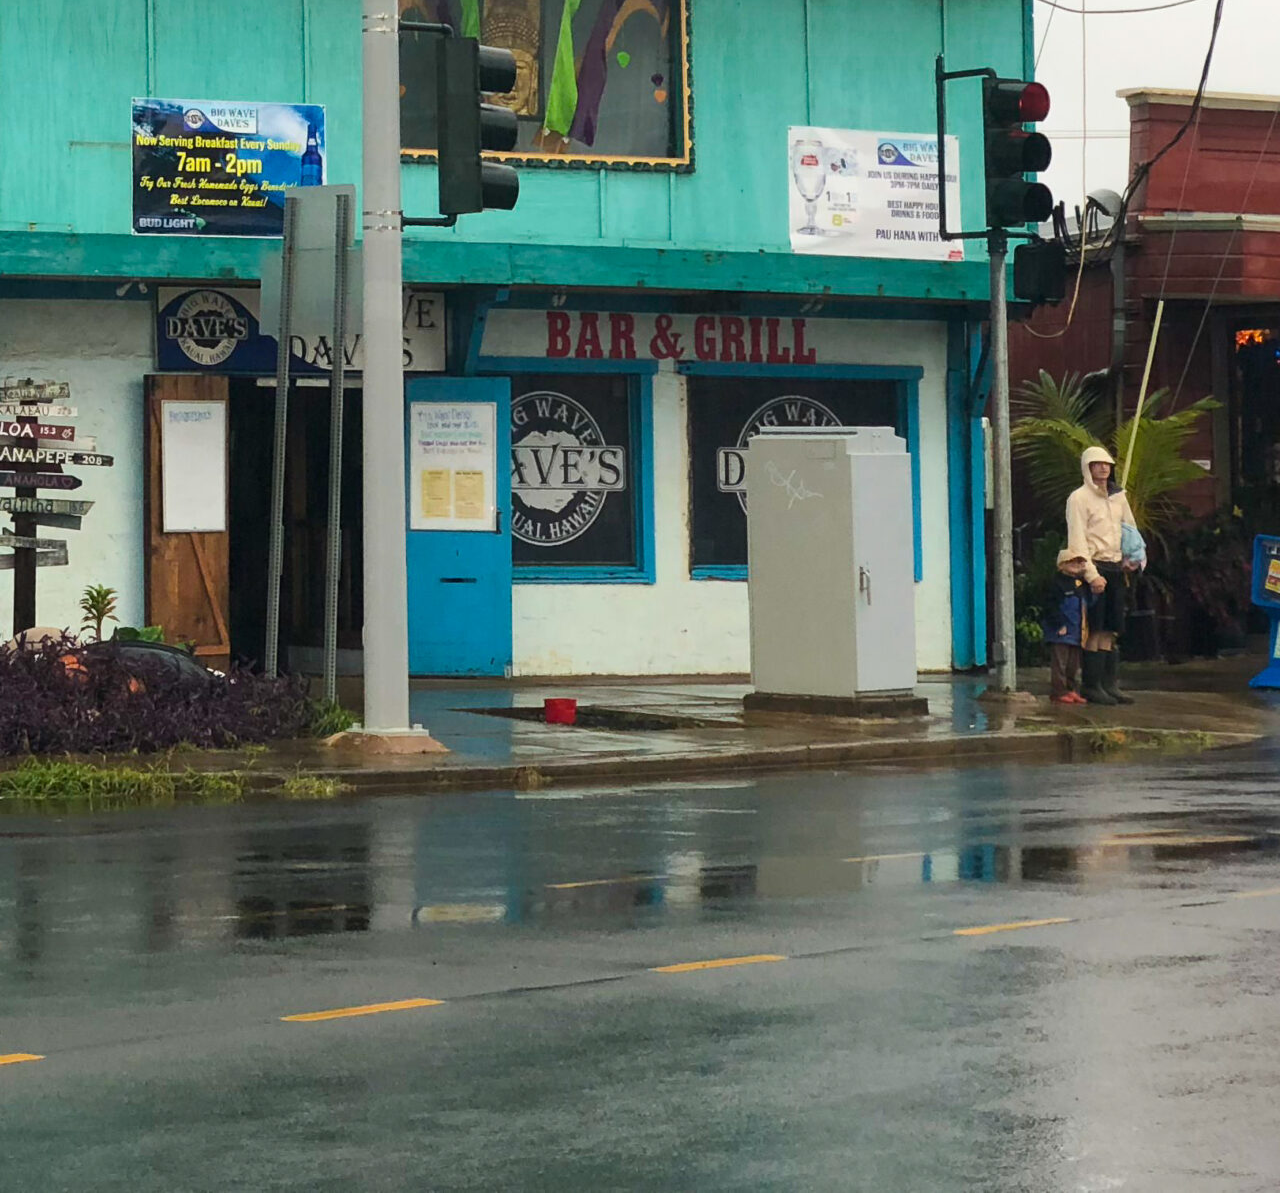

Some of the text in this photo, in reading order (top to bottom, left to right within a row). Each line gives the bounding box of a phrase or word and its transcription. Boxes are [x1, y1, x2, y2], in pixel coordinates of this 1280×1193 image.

[211, 108, 255, 118] BIG WAVE
[136, 135, 301, 152] Now Serving Breakfast Every Sunday
[176, 152, 210, 172] 7am
[226, 153, 262, 177] 2pm
[894, 172, 919, 181] DURING
[140, 176, 154, 190] Try
[157, 177, 171, 188] Our
[174, 177, 196, 189] Fresh
[198, 178, 238, 191] Homemade
[240, 179, 258, 196] Eggs
[170, 195, 188, 205] Best
[887, 200, 939, 211] BEST HAPPY HOU
[891, 210, 915, 218] DRINKS
[139, 218, 194, 228] BUD LIGHT
[876, 229, 892, 240] PAU
[894, 230, 917, 241] HANA
[918, 231, 939, 242] WITH
[169, 317, 246, 337] DAVE'S
[546, 310, 816, 365] BAR & GRILL
[534, 397, 596, 445] WAVE
[40, 426, 56, 435] 15.3
[512, 443, 621, 486] AVE'S
[4, 474, 59, 488] ANAHOLA
[549, 491, 599, 539] HAWAII
